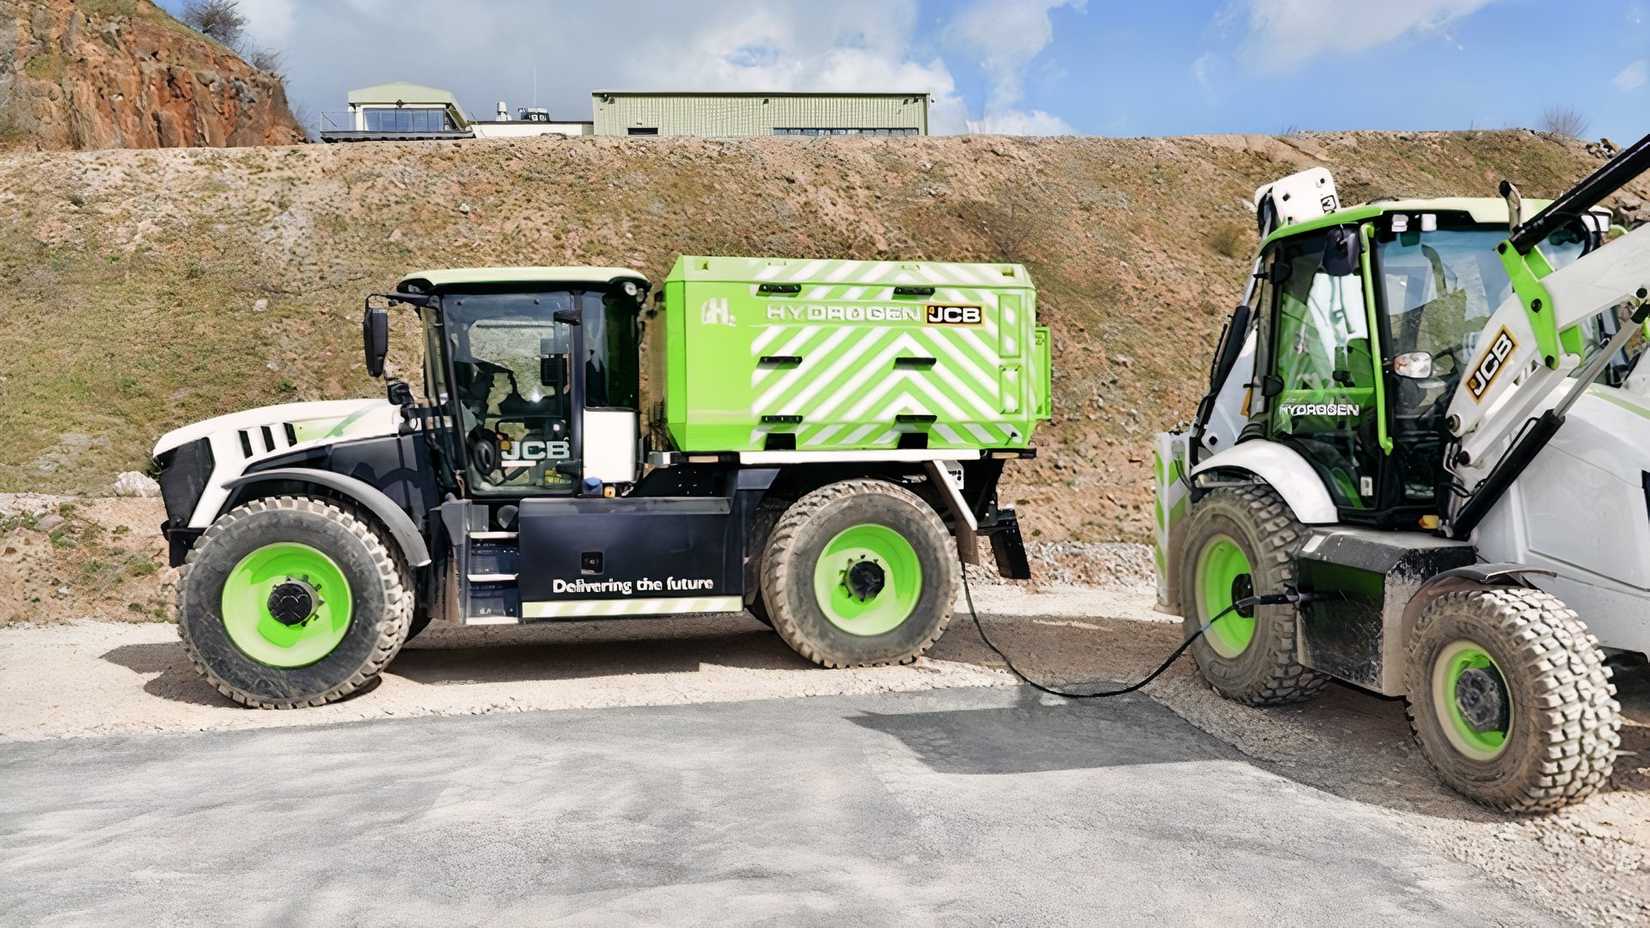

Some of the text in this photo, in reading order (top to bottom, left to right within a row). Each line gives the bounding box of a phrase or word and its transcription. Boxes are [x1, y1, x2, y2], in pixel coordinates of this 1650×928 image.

[767, 305, 981, 323] HYDROGEN JCB
[1468, 333, 1513, 396] JCB
[500, 440, 570, 460] JCB
[553, 576, 714, 595] Delivering the future
